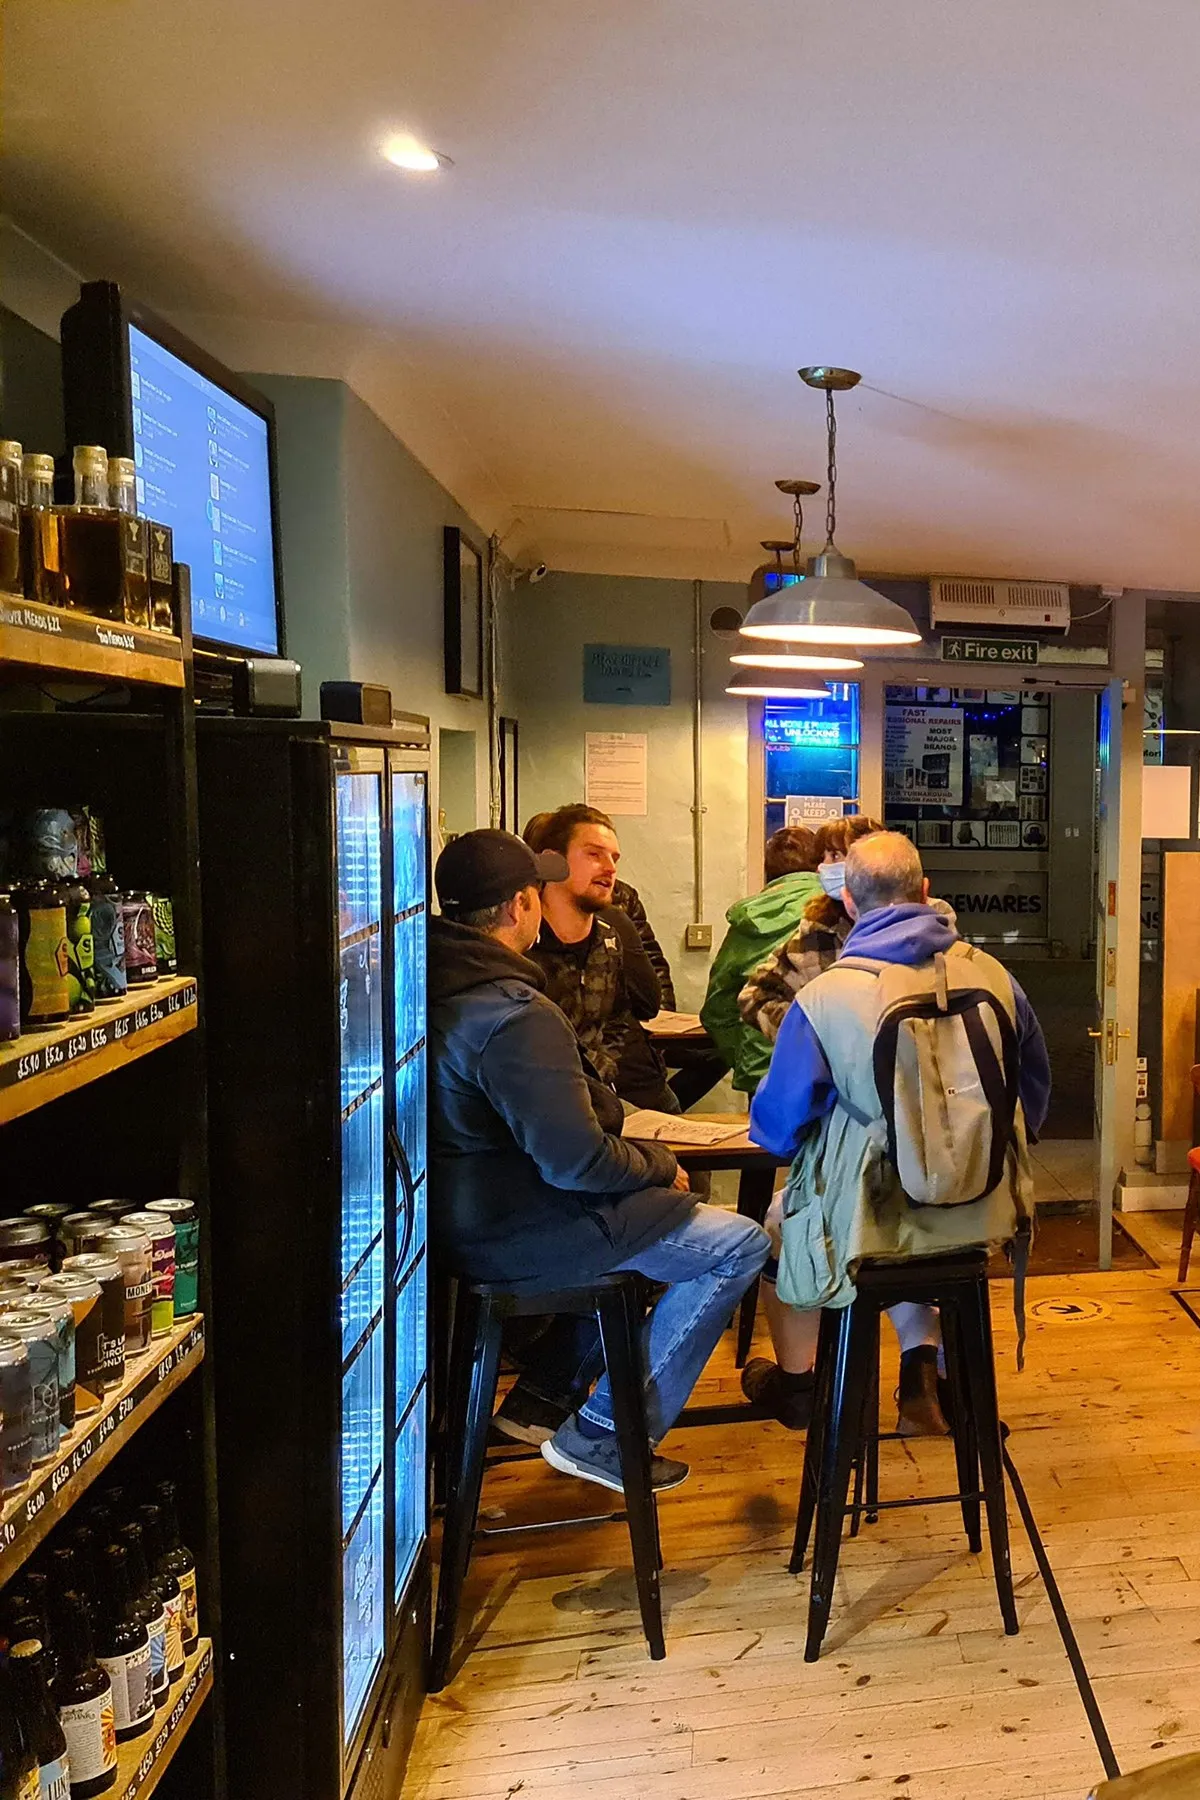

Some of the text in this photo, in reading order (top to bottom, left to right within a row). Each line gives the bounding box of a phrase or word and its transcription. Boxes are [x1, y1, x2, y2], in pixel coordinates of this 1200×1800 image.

[965, 643, 1034, 660] Fire exit
[902, 709, 926, 717] FAST
[784, 728, 839, 738] UNLOCKING
[804, 808, 826, 817] KEEP
